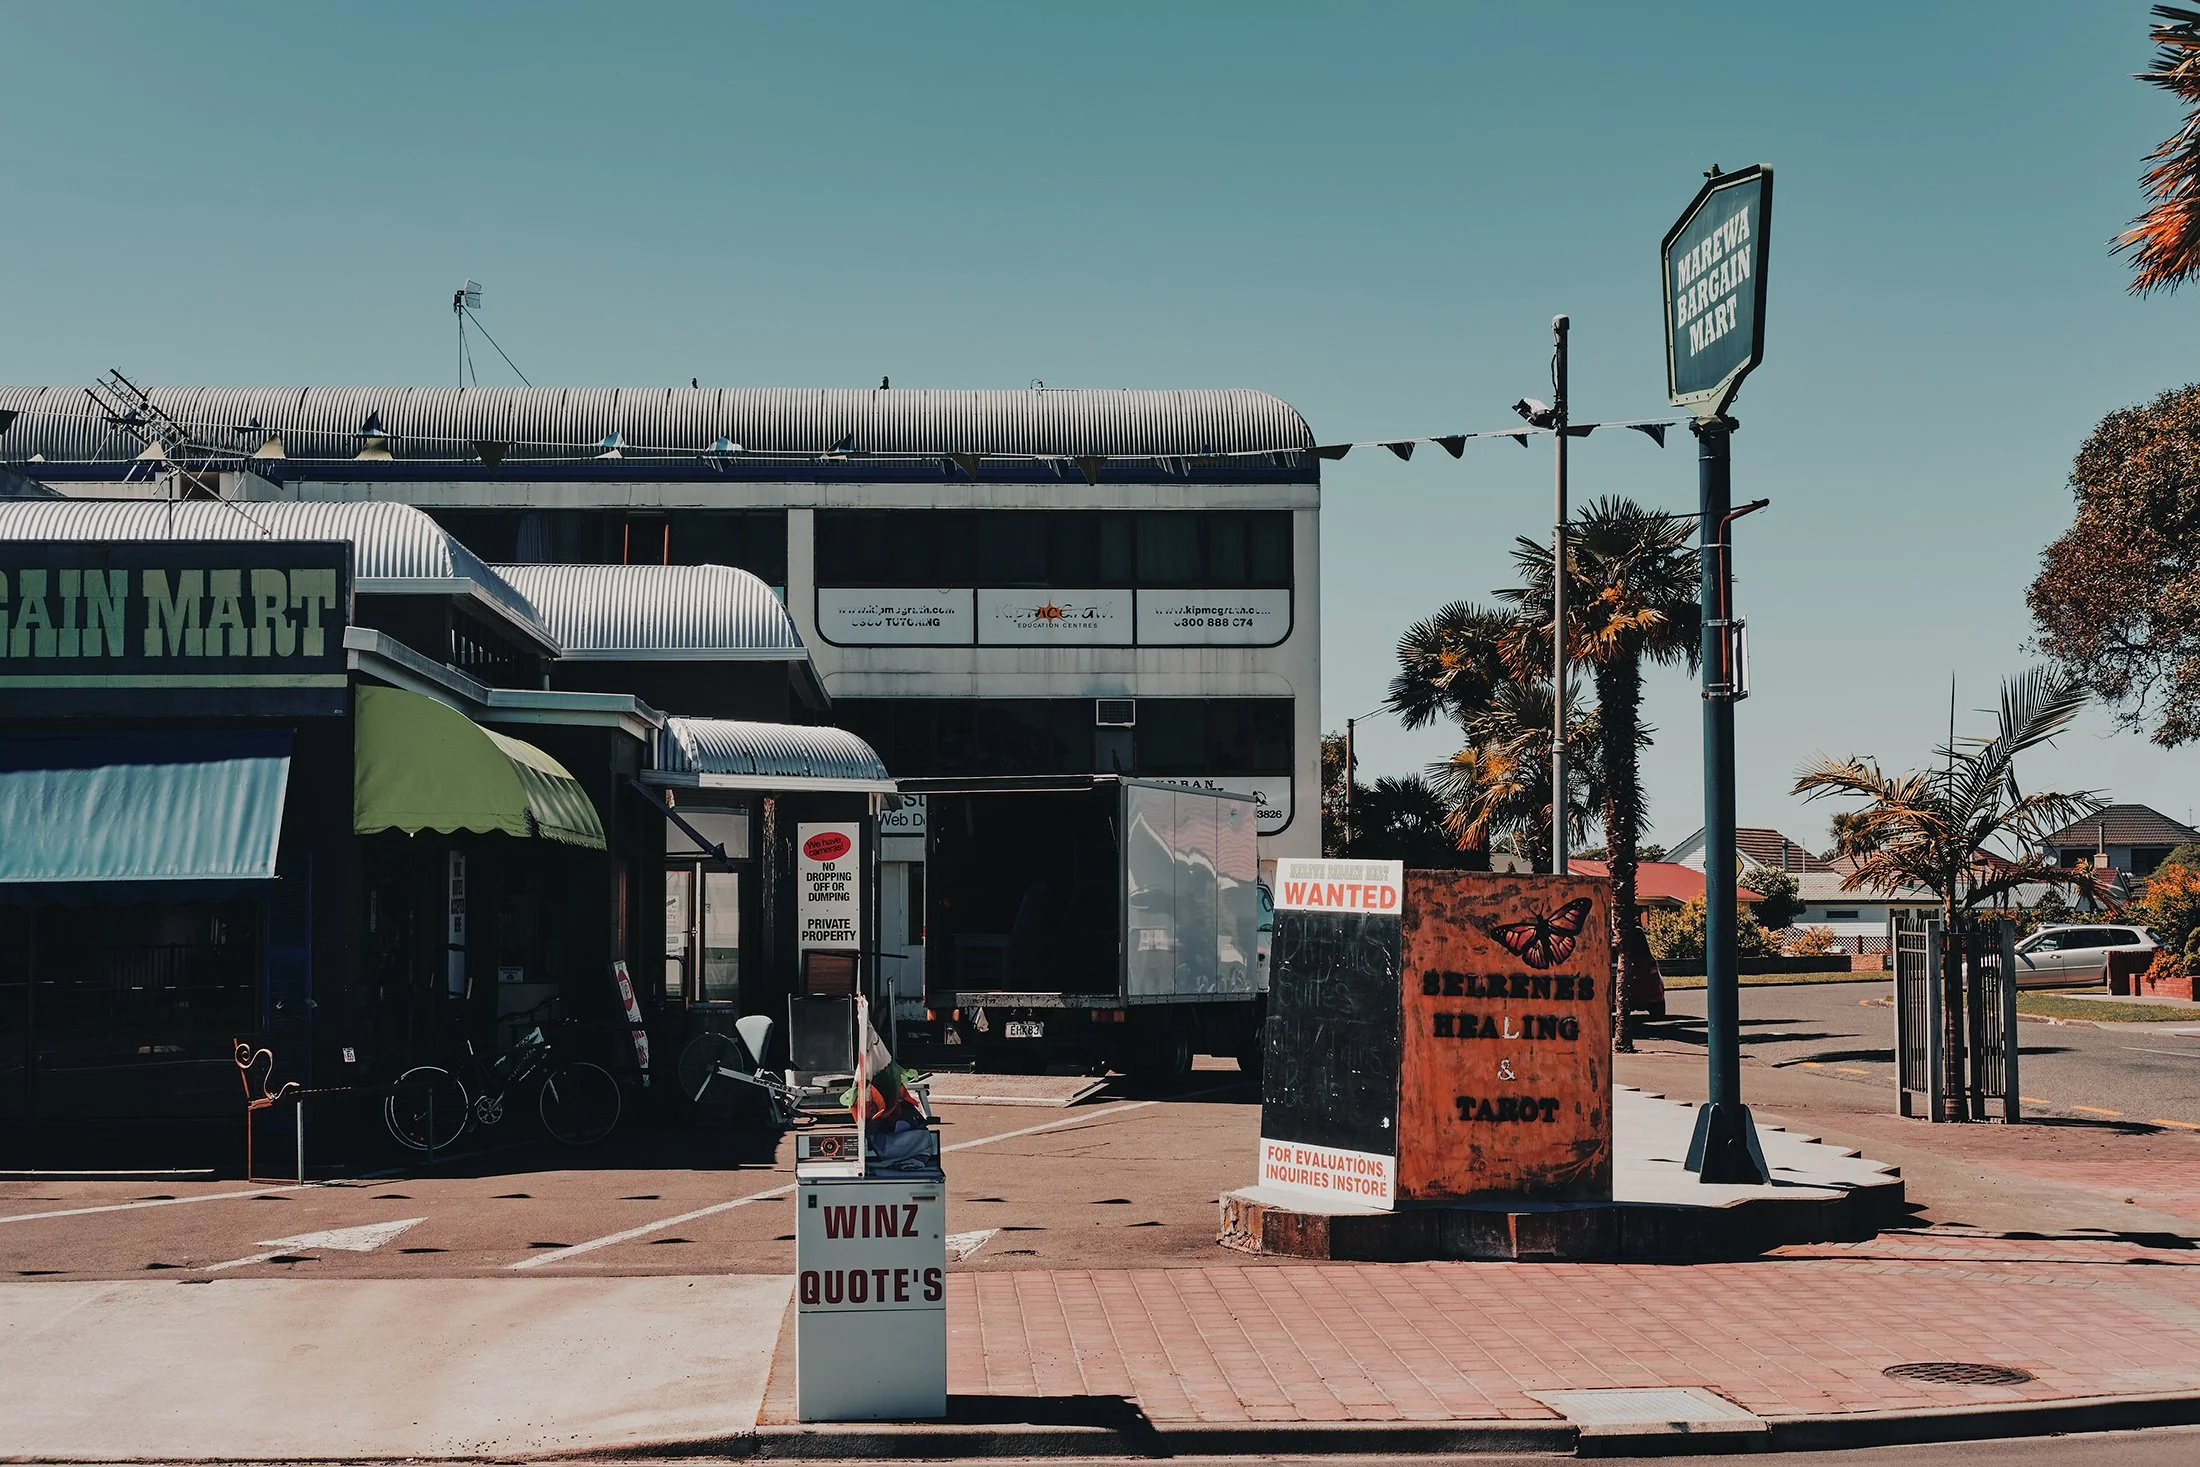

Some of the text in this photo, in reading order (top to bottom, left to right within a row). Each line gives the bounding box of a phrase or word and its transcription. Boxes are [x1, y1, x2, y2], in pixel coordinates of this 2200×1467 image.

[1678, 206, 1750, 292] MAREWA
[1677, 243, 1751, 329] BARGAIN
[1689, 293, 1737, 357] MART
[0, 569, 337, 657] AIN MART
[1207, 618, 1229, 627] 888
[880, 812, 909, 827] Web
[807, 837, 842, 849] We have
[808, 843, 844, 858] cameras!
[806, 872, 852, 881] DROPPING
[822, 862, 835, 871] NO
[808, 892, 850, 901] DUMPING
[813, 882, 845, 891] OFF OR
[1284, 881, 1397, 909] WANTED
[801, 930, 857, 941] PROPERTY
[807, 918, 851, 929] PRIVATE
[1433, 1013, 1580, 1041] HEALING
[1497, 1057, 1516, 1081] &
[1456, 1096, 1560, 1123] TAROT
[1267, 1145, 1387, 1180] FOR EVALUATIONS,
[1265, 1163, 1388, 1198] INQUIRIES INSTORE
[823, 1204, 919, 1239] WINZ
[800, 1267, 943, 1306] QUOTE'S
